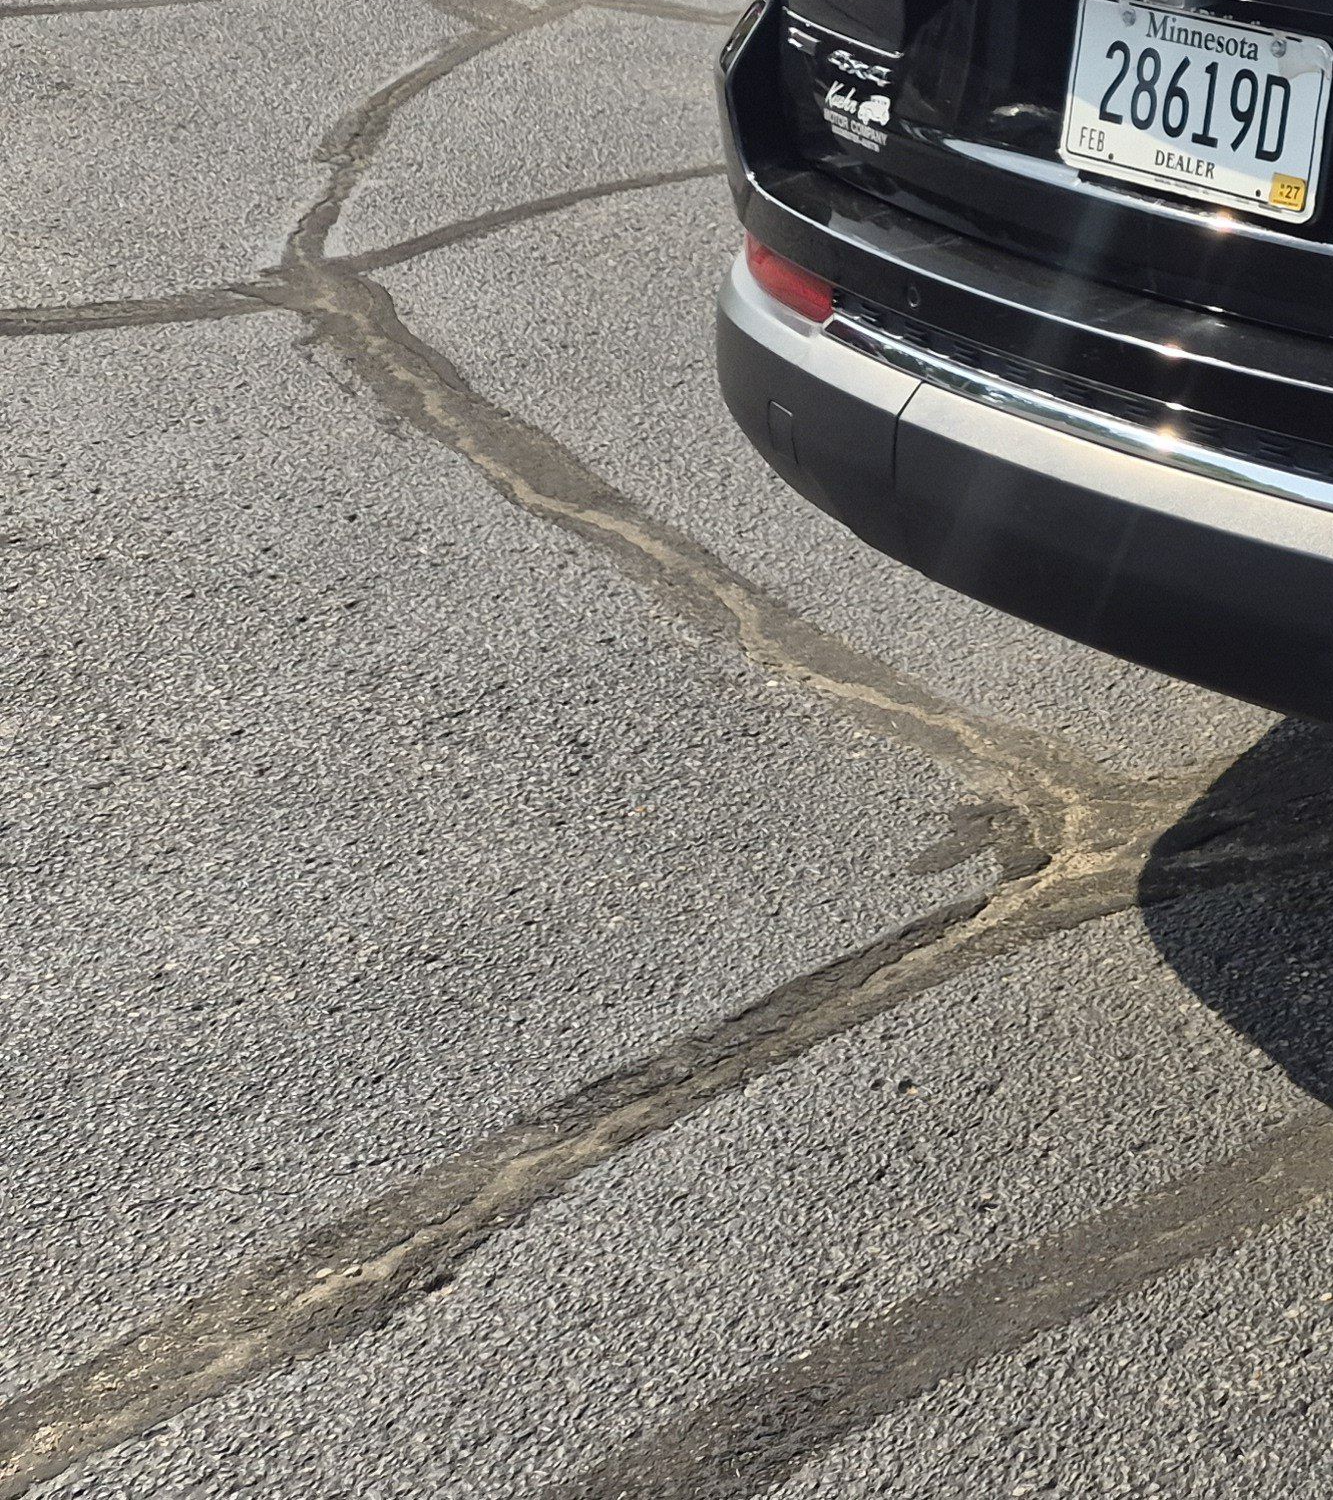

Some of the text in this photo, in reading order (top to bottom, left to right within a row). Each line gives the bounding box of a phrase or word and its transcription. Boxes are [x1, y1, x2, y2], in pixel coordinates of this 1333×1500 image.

[1146, 12, 1259, 61] Minnesota
[1099, 40, 1291, 162] 28619D
[1079, 126, 1105, 152] FEB
[1154, 150, 1216, 179] DEALER
[1285, 184, 1301, 200] 27
